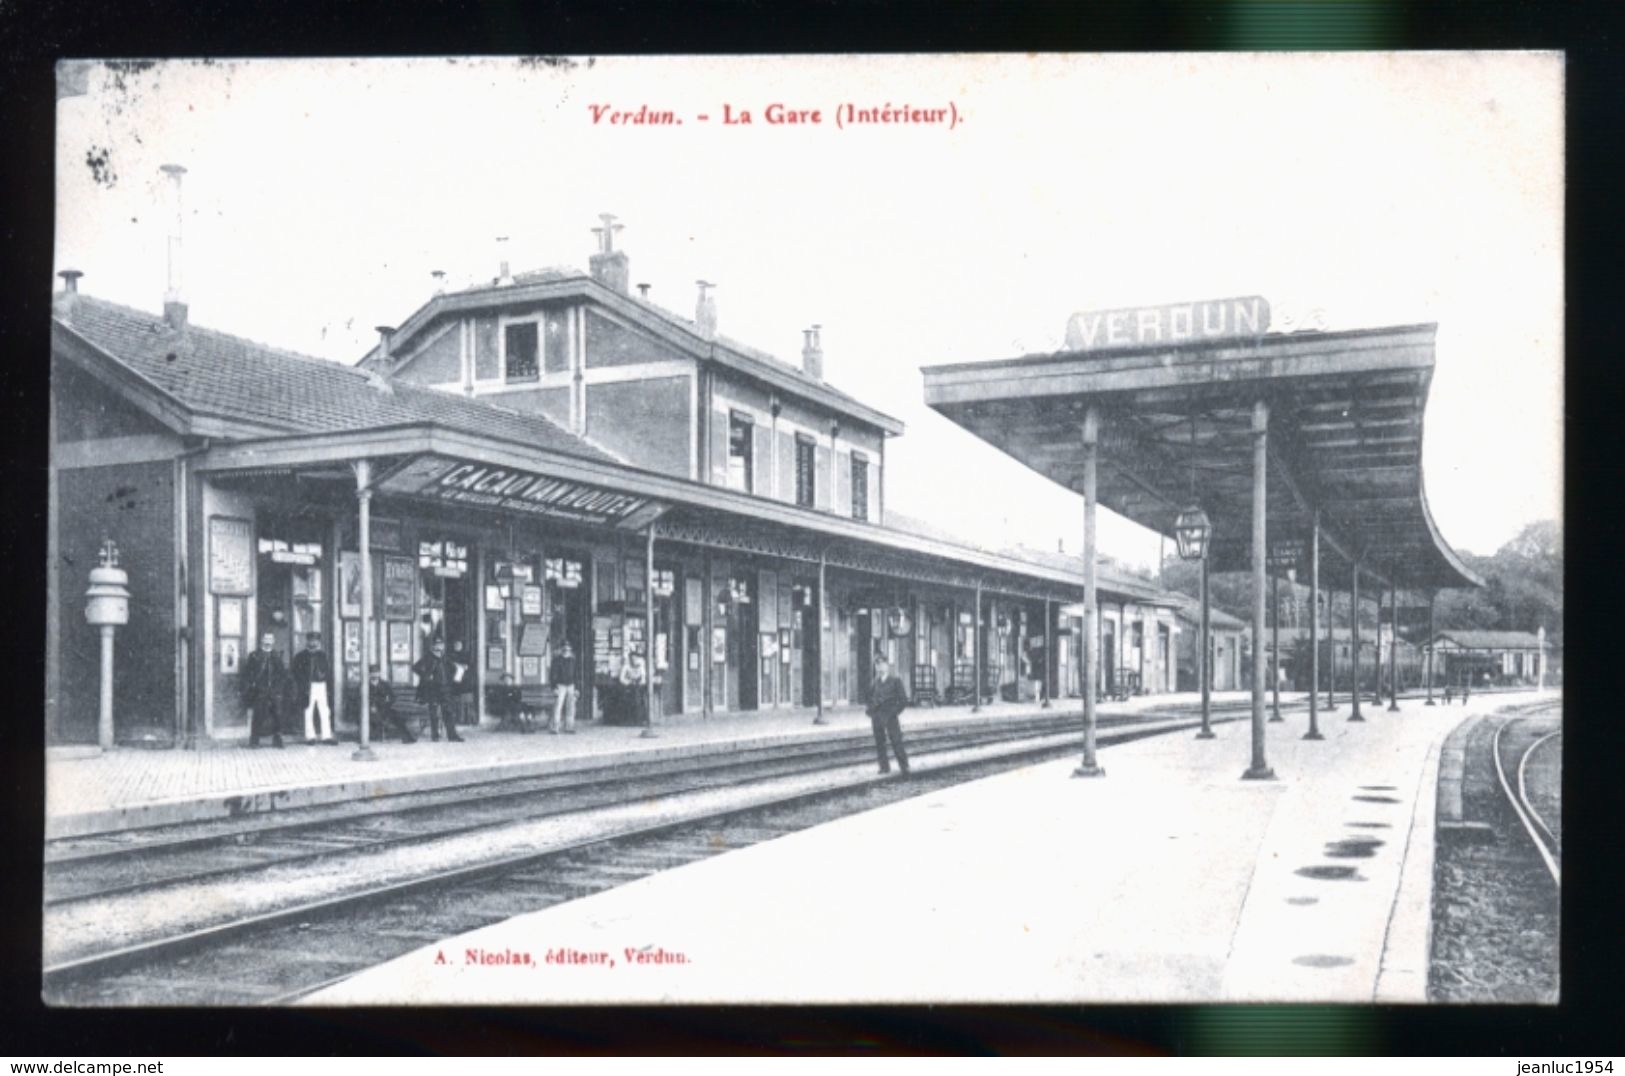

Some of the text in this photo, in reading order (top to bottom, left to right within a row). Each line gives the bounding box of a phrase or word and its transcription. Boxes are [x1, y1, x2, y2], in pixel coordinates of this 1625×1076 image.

[1077, 299, 1260, 348] VERDUN
[441, 464, 534, 496] CACAO
[521, 476, 569, 503] VAN
[560, 485, 648, 516] HOUTEN
